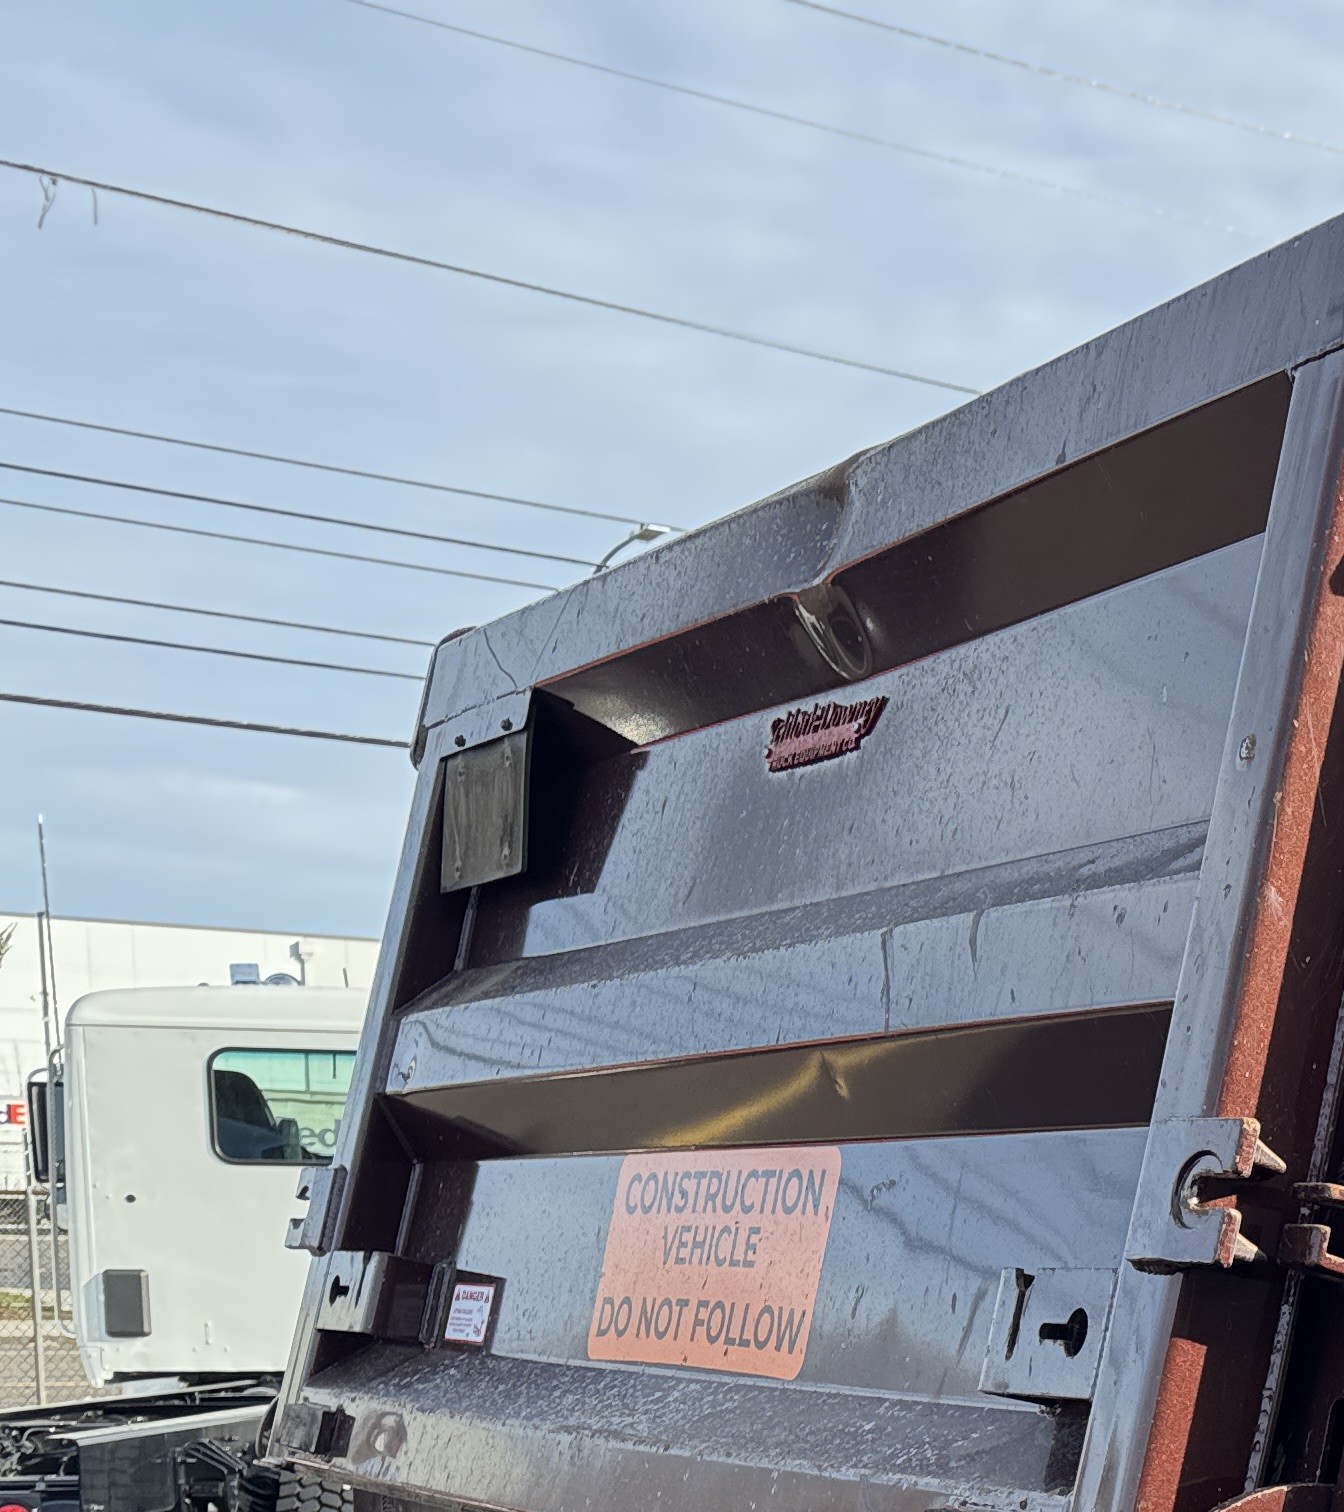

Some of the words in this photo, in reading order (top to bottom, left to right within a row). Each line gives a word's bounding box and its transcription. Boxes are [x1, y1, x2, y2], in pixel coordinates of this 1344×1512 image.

[625, 1168, 827, 1216] CONSTRUCTION
[661, 1224, 762, 1268] VEHICLE
[596, 1296, 633, 1338] DO
[635, 1296, 690, 1341] NOT
[690, 1300, 807, 1355] FOLLOW
